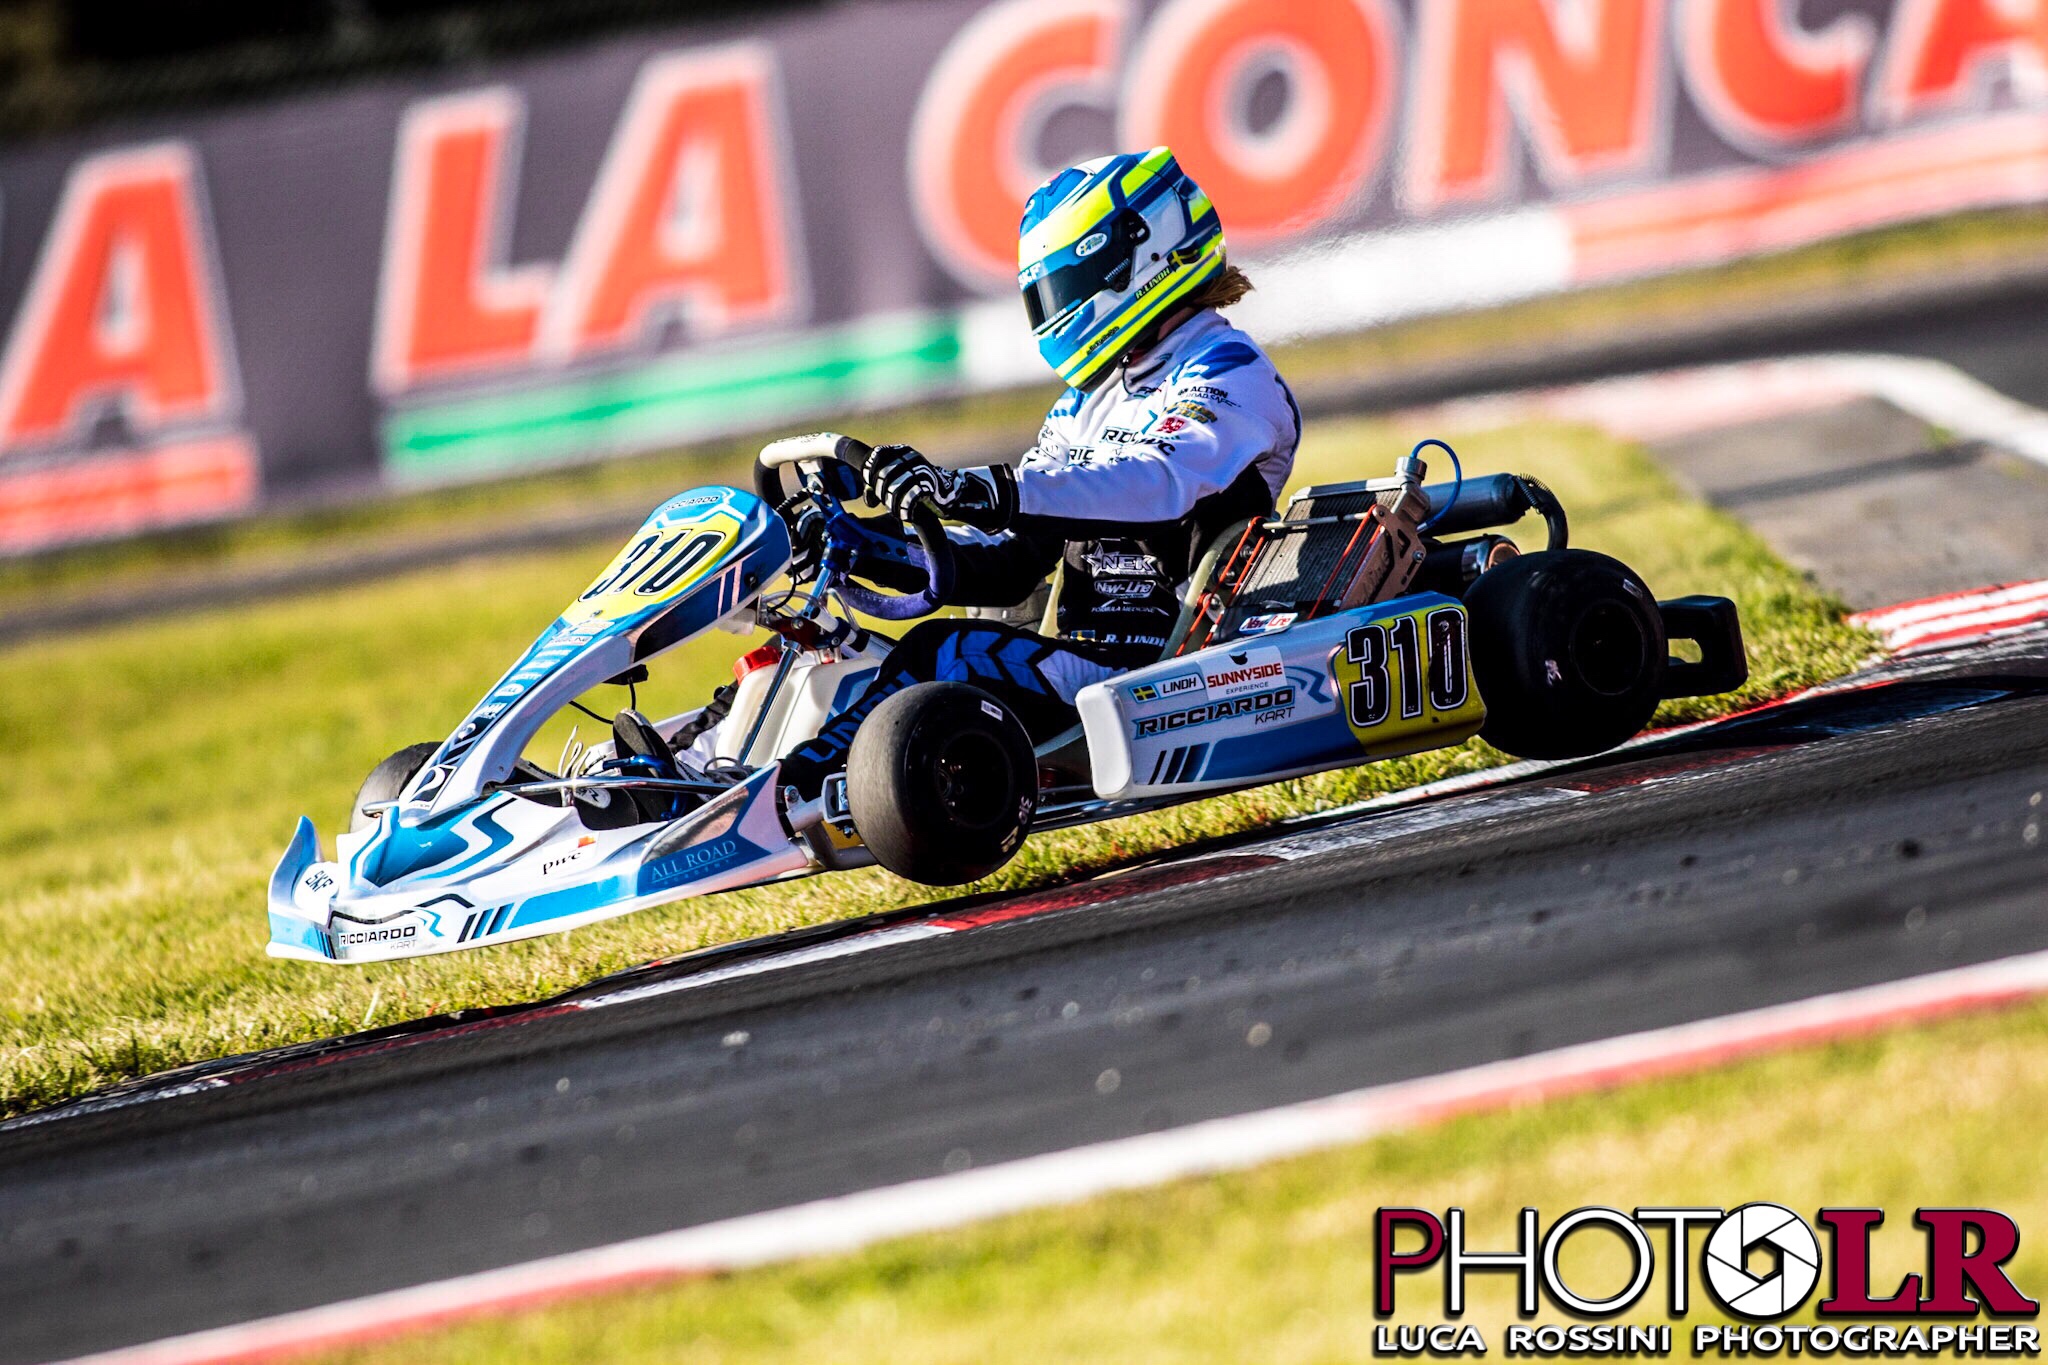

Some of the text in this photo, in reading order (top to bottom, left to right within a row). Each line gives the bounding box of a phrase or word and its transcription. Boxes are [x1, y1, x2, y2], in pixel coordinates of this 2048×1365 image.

[376, 44, 800, 390] LA
[1135, 267, 1170, 300] R.LINDH
[1191, 386, 1228, 398] ACTION
[578, 528, 726, 602] 310
[1207, 663, 1283, 688] SUNNYSIDE
[1346, 607, 1468, 728] 310
[1162, 677, 1197, 694] LINDH
[1226, 681, 1269, 695] EXPERIENCE
[1138, 689, 1293, 736] RICCIARDO
[1255, 706, 1295, 724] KART
[543, 852, 581, 875] pwc
[651, 862, 682, 880] ALL
[686, 840, 737, 868] ROAD
[305, 870, 334, 892] SKF
[340, 926, 416, 945] RICCIARDO
[391, 939, 417, 949] KART
